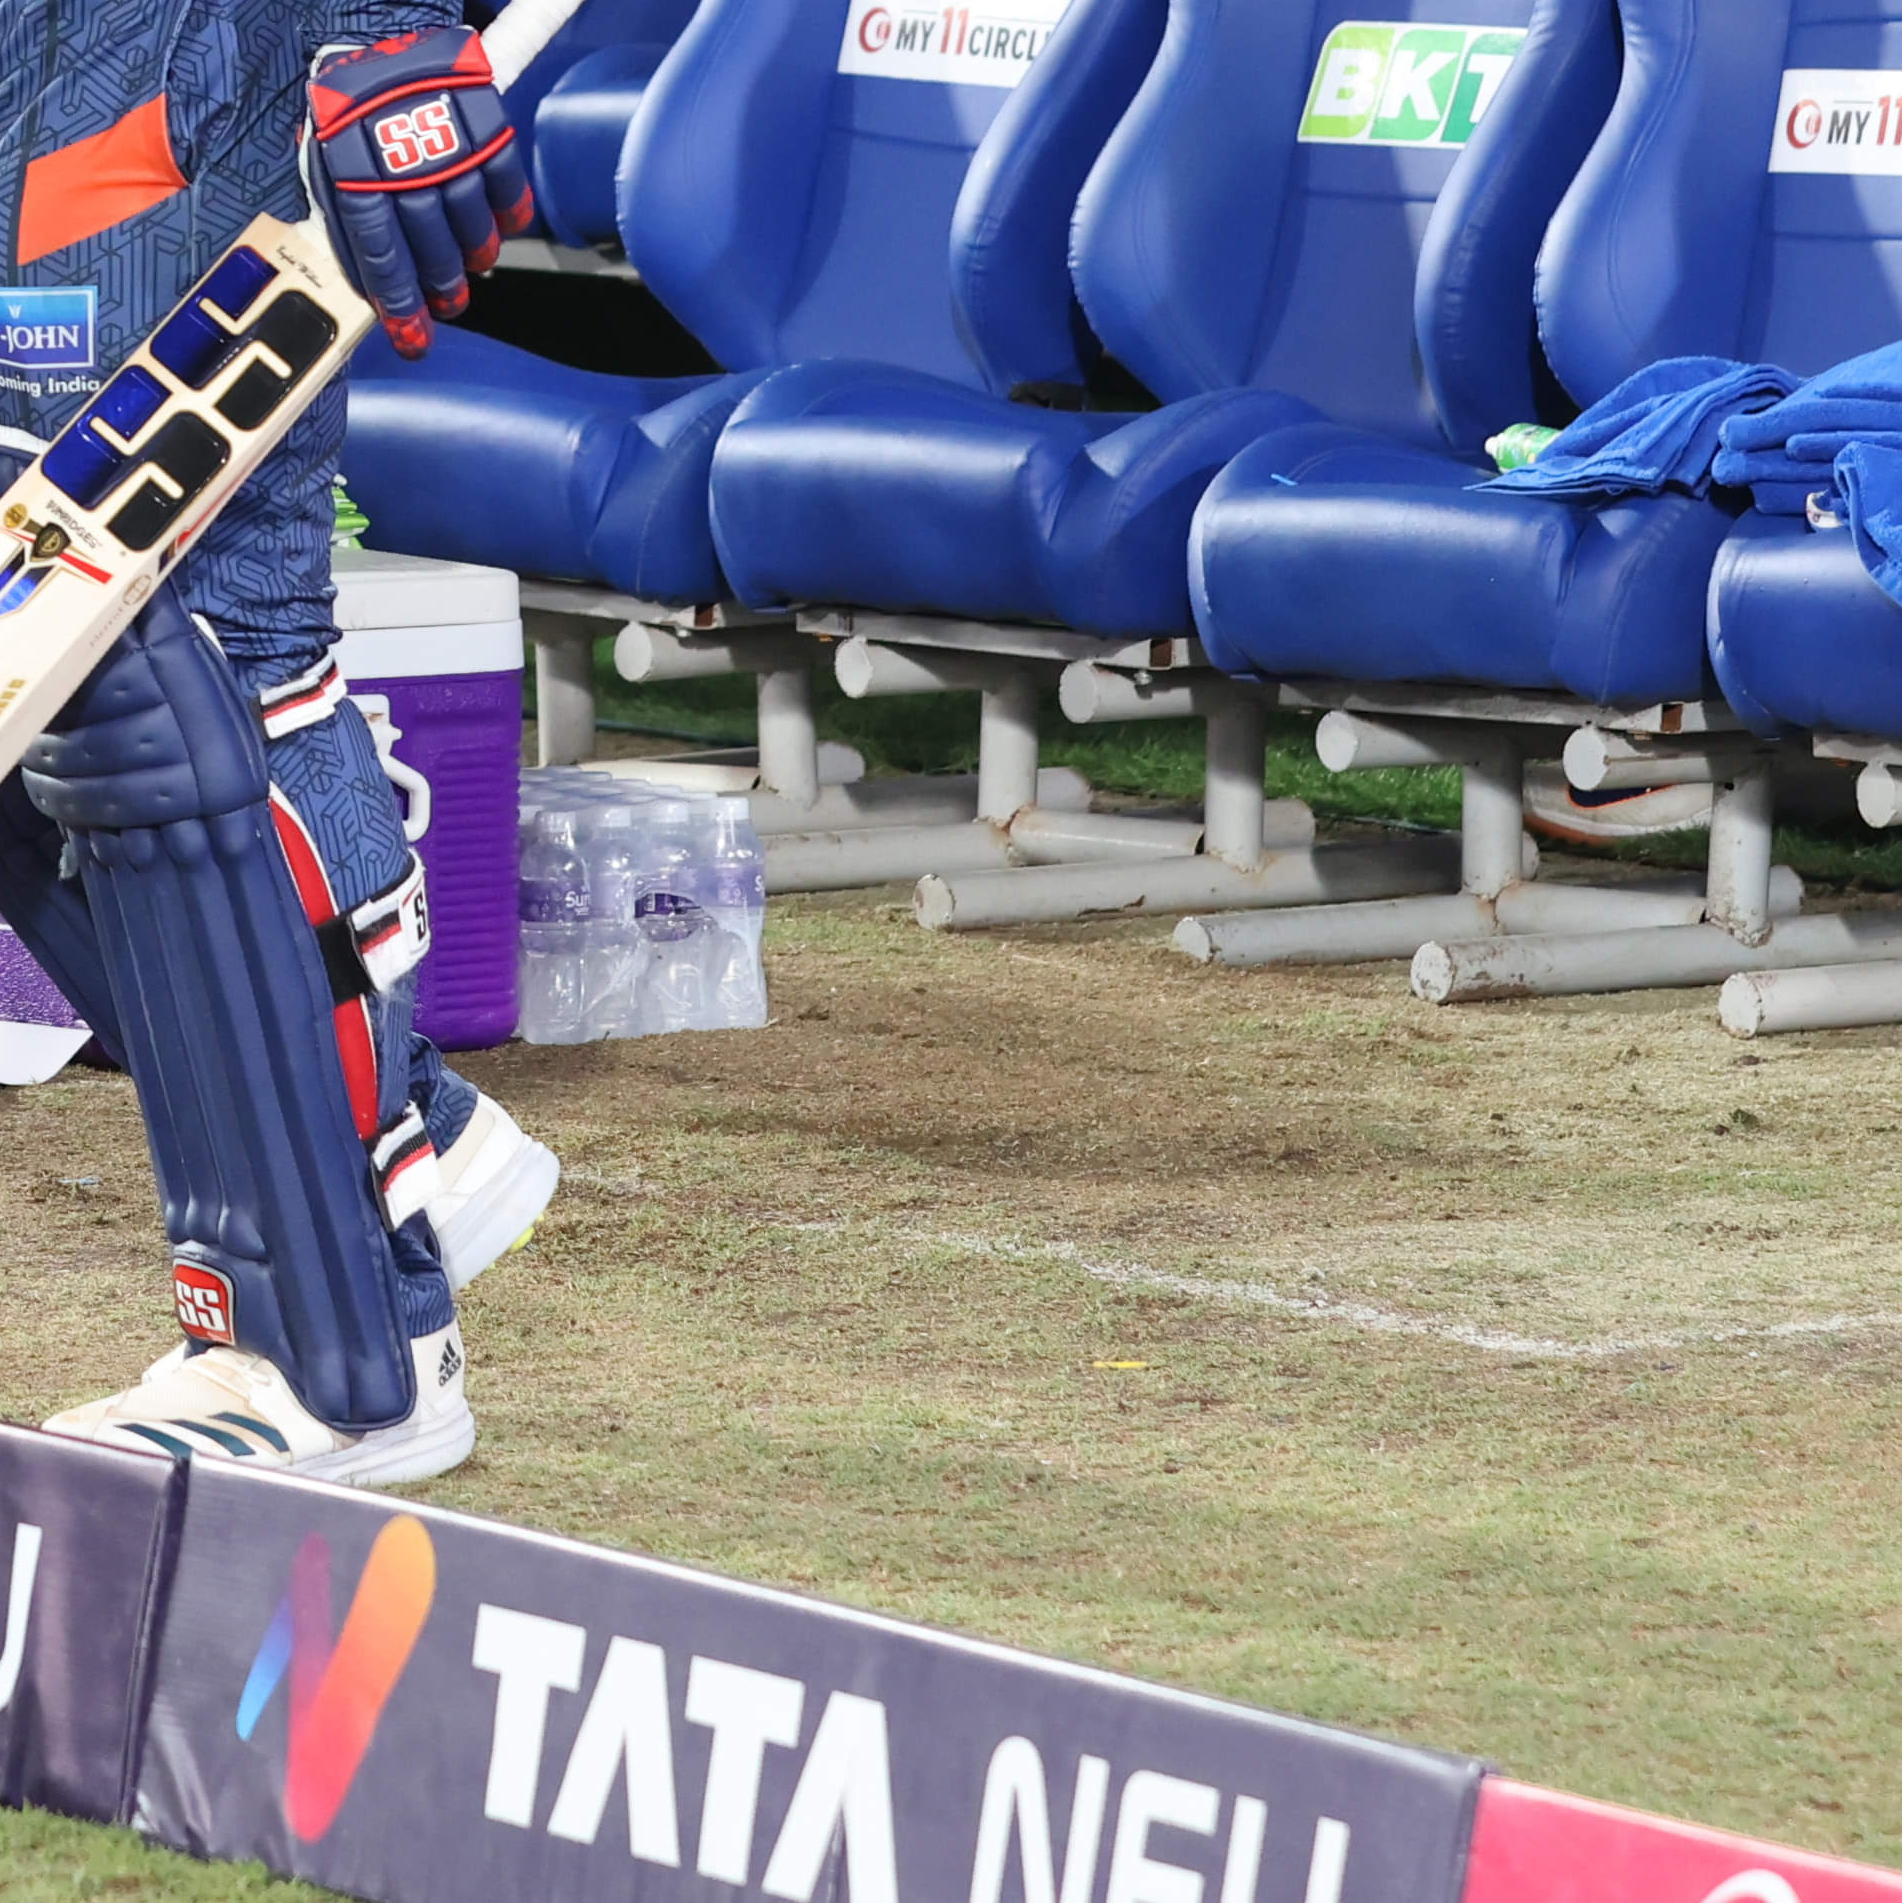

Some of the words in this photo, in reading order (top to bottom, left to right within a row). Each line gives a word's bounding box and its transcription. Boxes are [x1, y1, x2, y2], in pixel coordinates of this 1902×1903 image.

[894, 6, 1054, 62] MY11CIRCL
[374, 100, 460, 174] SS
[47, 375, 101, 394] India
[175, 1279, 227, 1333] SS
[469, 1603, 894, 1903] TATA
